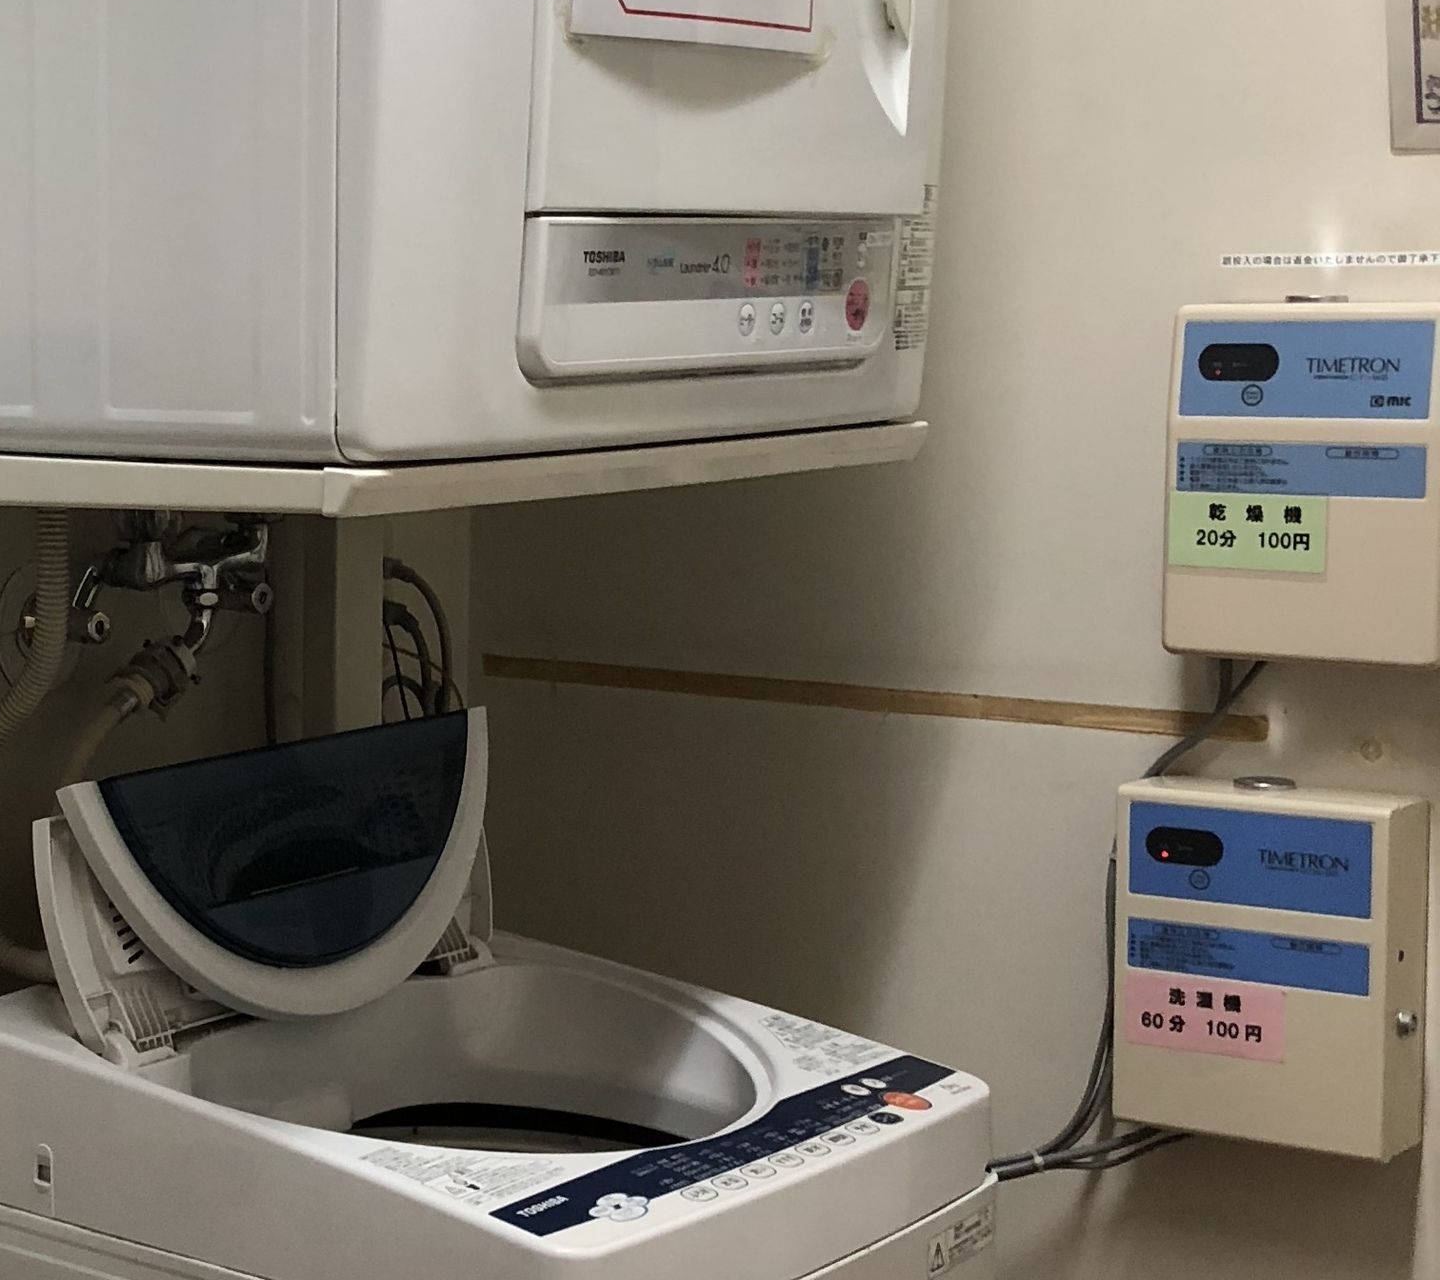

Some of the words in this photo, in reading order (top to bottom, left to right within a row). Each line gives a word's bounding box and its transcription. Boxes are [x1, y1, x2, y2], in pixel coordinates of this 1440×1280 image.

[583, 251, 626, 264] TOSHIBA
[1305, 357, 1401, 374] TIMETRON
[1208, 503, 1304, 525] 乾燥機
[1196, 529, 1237, 548] 20分
[1258, 531, 1311, 551] 100円
[1258, 848, 1351, 873] TIMETRON
[1168, 987, 1242, 1013] 洗濯機
[1141, 1011, 1186, 1033] 60分
[1206, 1019, 1263, 1043] 100円
